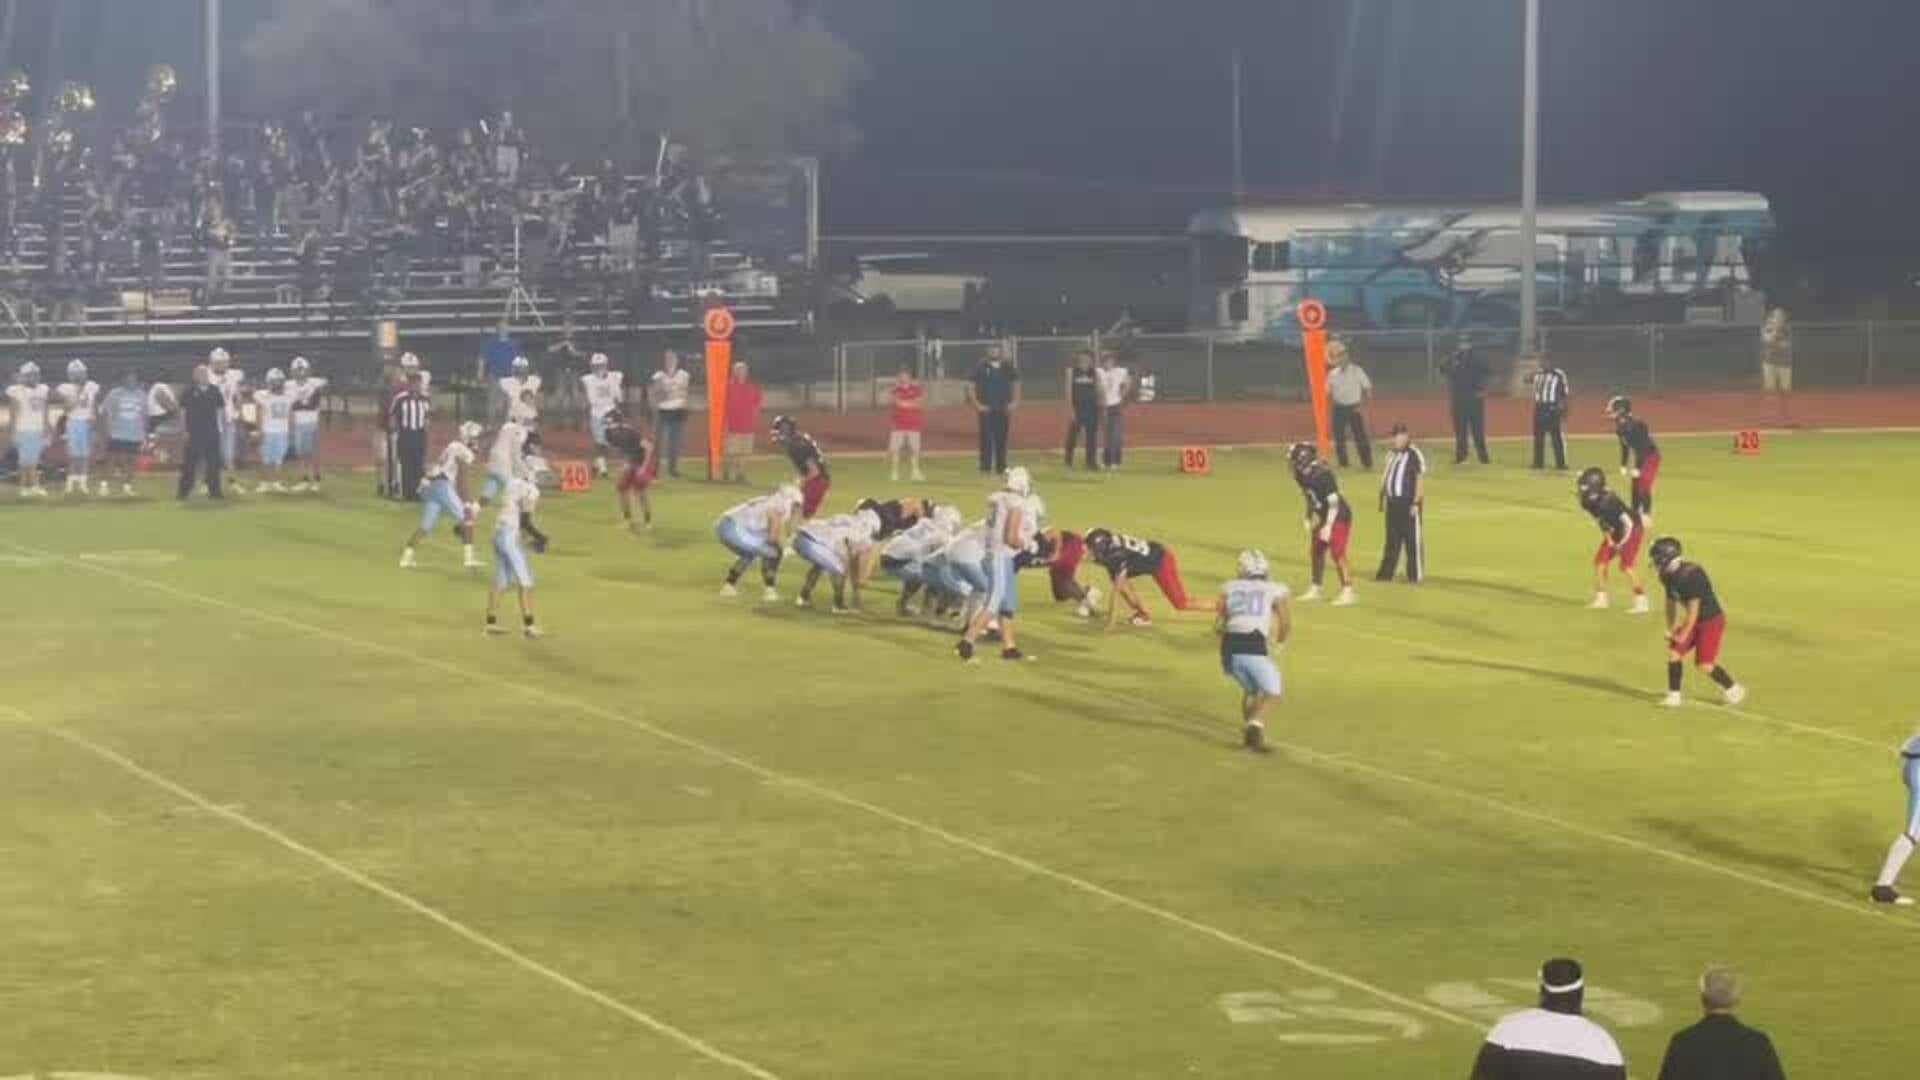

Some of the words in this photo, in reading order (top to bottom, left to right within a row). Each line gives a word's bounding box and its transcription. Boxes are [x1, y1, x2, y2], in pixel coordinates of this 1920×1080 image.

[1740, 431, 1760, 449] 20
[1185, 449, 1206, 469] 30
[564, 464, 587, 487] 40
[1230, 590, 1265, 616] 20
